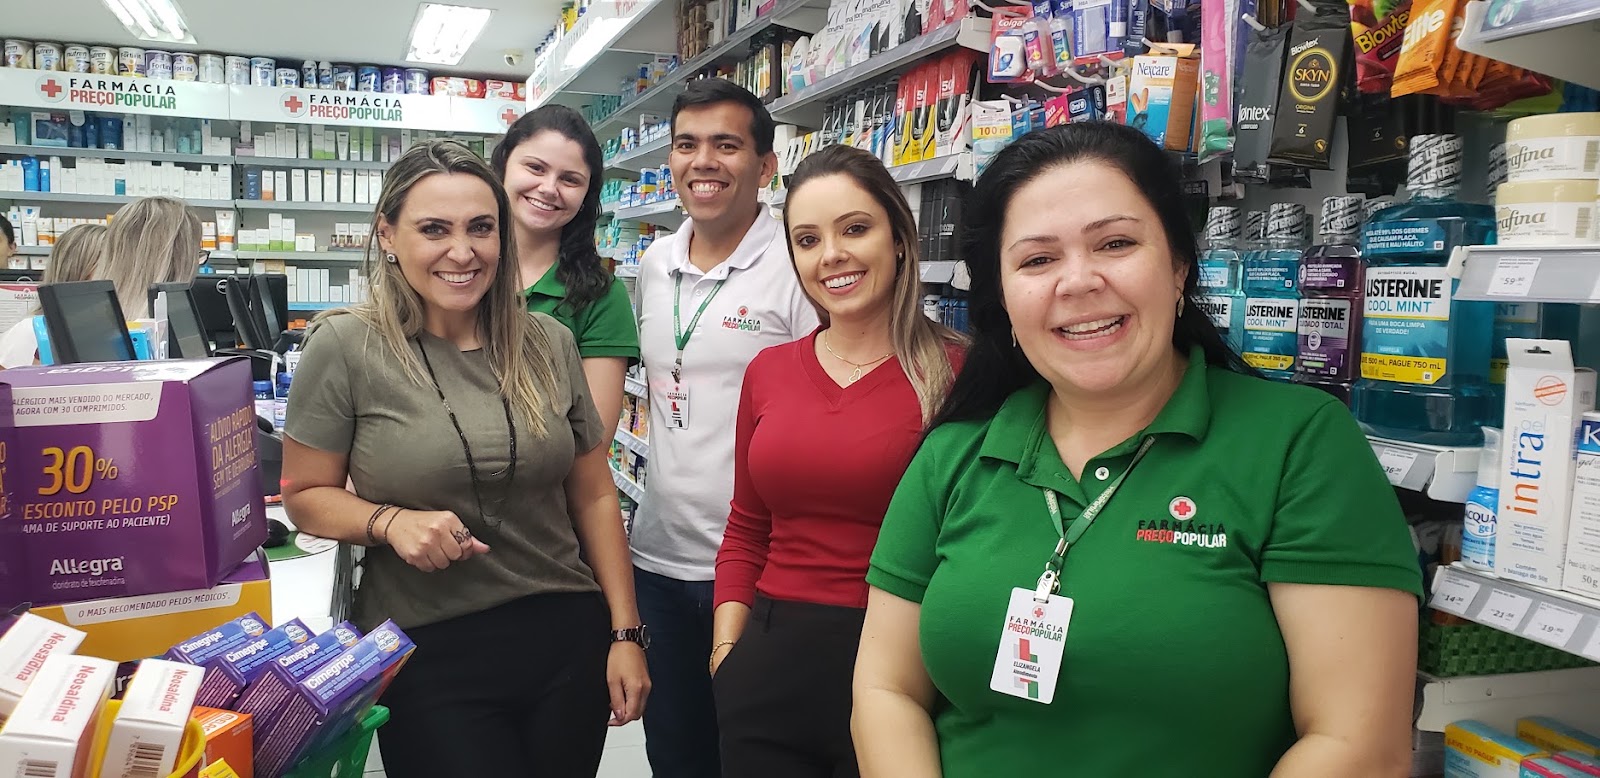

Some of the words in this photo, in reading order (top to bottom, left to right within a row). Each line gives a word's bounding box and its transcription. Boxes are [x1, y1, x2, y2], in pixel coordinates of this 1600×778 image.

[1290, 37, 1319, 56] Blowtex
[1137, 62, 1170, 79] Nexcare
[1295, 68, 1330, 82] SKYN
[69, 77, 176, 96] FARMÁCIA
[70, 89, 177, 110] PREÇOPOPULAR
[309, 93, 402, 109] FARMÁCIA
[310, 105, 402, 121] PREÇOPOPULAR
[980, 127, 997, 135] 100
[1403, 239, 1424, 248] HÁLITO
[1366, 279, 1442, 299] LISTERINE
[1246, 305, 1294, 319] LISTERINE
[1368, 300, 1392, 312] COOL
[1396, 301, 1432, 313] MINT
[723, 315, 761, 325] FARMÁCIA
[1247, 318, 1263, 327] COOL
[1265, 319, 1287, 328] MINT
[1321, 321, 1345, 330] TOTAL
[1389, 359, 1412, 368] PAGUE
[1414, 361, 1427, 369] 750
[1430, 362, 1442, 370] mL
[49, 396, 66, 405] MAIS
[69, 395, 100, 404] VENDIDO
[103, 394, 114, 402] DO
[16, 407, 41, 415] AGORA
[43, 406, 58, 414] COM
[61, 405, 70, 413] 30
[73, 403, 127, 413] COMPRIMIDOS.
[213, 444, 224, 471] DA
[1506, 432, 1545, 516] intra
[22, 498, 97, 521] ESCONTO
[101, 496, 142, 515] PELO
[147, 494, 180, 513] PSP
[232, 502, 251, 528] Allegra
[46, 521, 60, 533] DE
[61, 519, 105, 532] SUPORTE
[107, 518, 121, 530] AO
[123, 513, 172, 529] PACIENTE)
[1138, 517, 1226, 535] FARMÁCIA
[1478, 523, 1494, 534] gel
[1136, 529, 1227, 548] PREÇOPOPULAR
[50, 555, 123, 577] Allegra
[1515, 563, 1537, 572] Contém
[1581, 576, 1592, 586] 50
[78, 608, 84, 618] O
[87, 606, 107, 617] MAIS
[109, 599, 167, 615] RECOMENDADO
[168, 596, 192, 607] PELOS
[1008, 622, 1062, 642] PREÇOPOPULAR
[1009, 615, 1063, 633] FARMÁCIA
[181, 630, 224, 654] Cimegripe
[226, 637, 269, 663] Cimegripe
[16, 631, 66, 683] Neosaldina
[278, 642, 320, 667] Cimegripe
[306, 653, 356, 689] Cimegripe
[1013, 660, 1041, 673] ELIZANGELA
[51, 665, 99, 723] Neosaldina
[158, 668, 188, 714] Neosaldina
